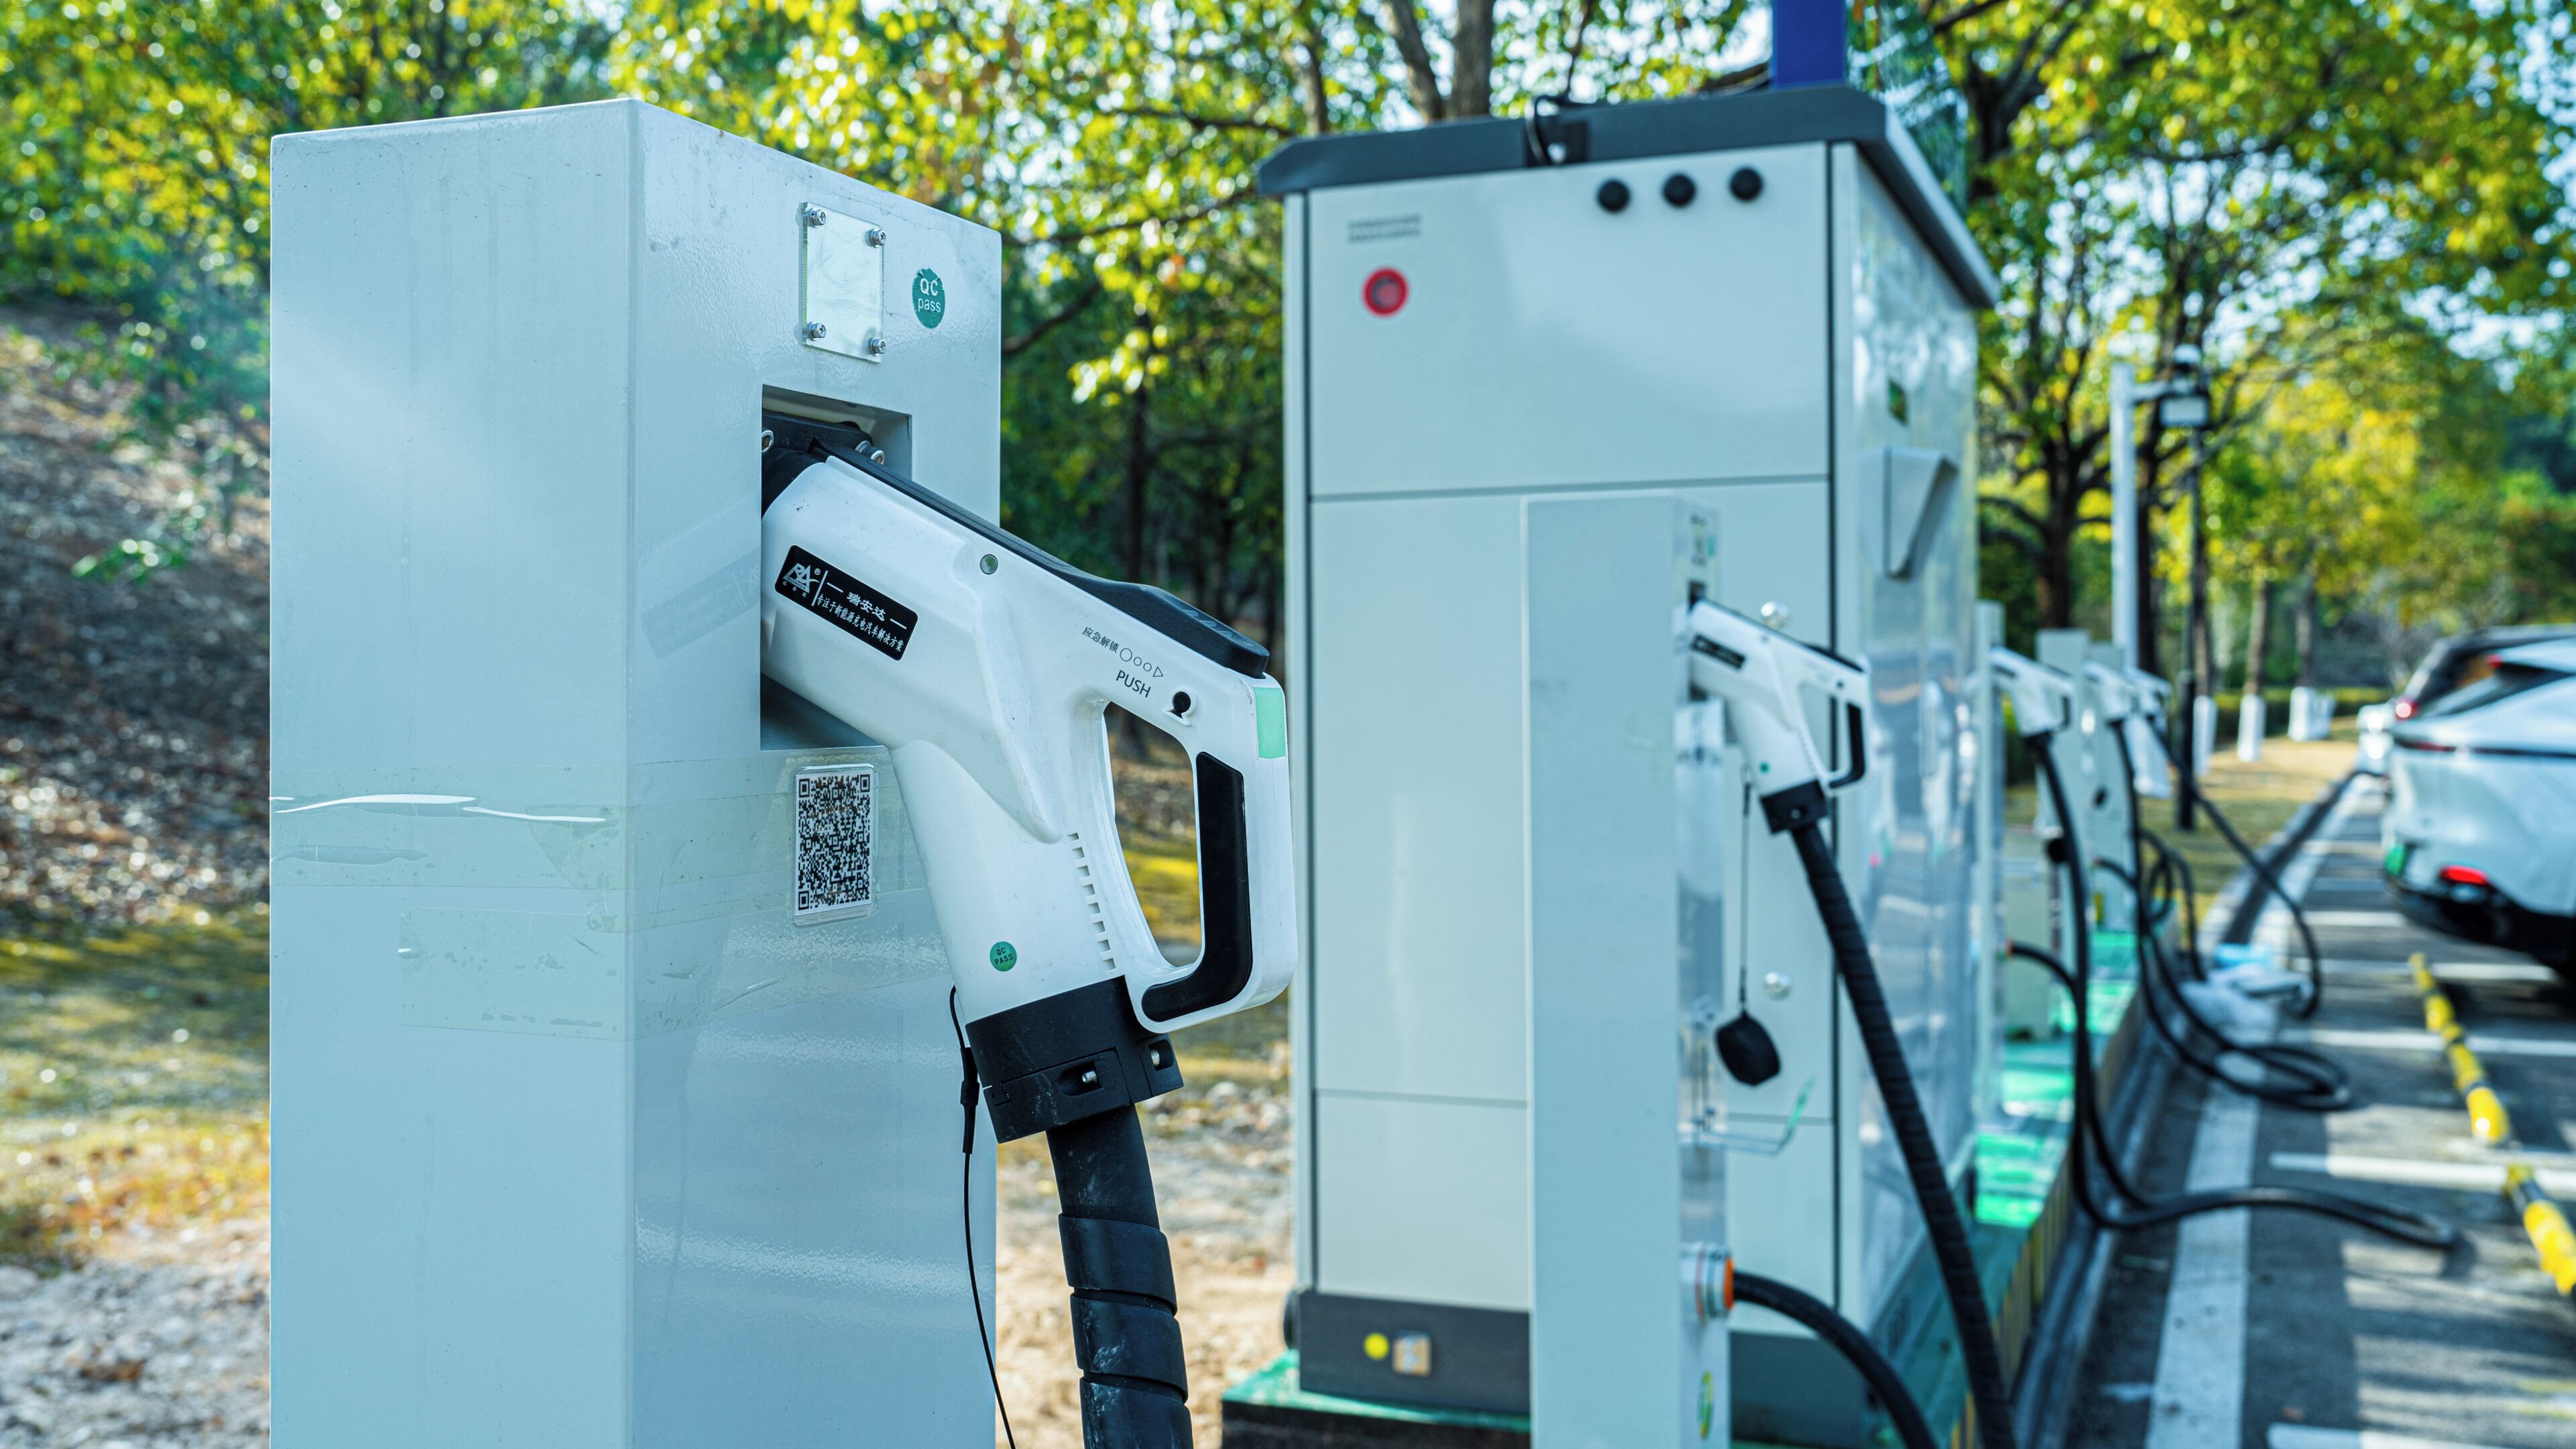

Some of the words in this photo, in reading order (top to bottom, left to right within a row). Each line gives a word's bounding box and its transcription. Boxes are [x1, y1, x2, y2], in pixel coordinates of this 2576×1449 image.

[920, 278, 938, 297] QC
[918, 298, 941, 313] pass
[847, 592, 886, 621] 瑞安达
[817, 594, 904, 651] 专注于新能源充电汽车解决方案
[1081, 627, 1120, 653] 应急解锁
[1116, 669, 1151, 698] PUSH
[994, 953, 1014, 965] PASS
[996, 947, 1006, 956] QC
